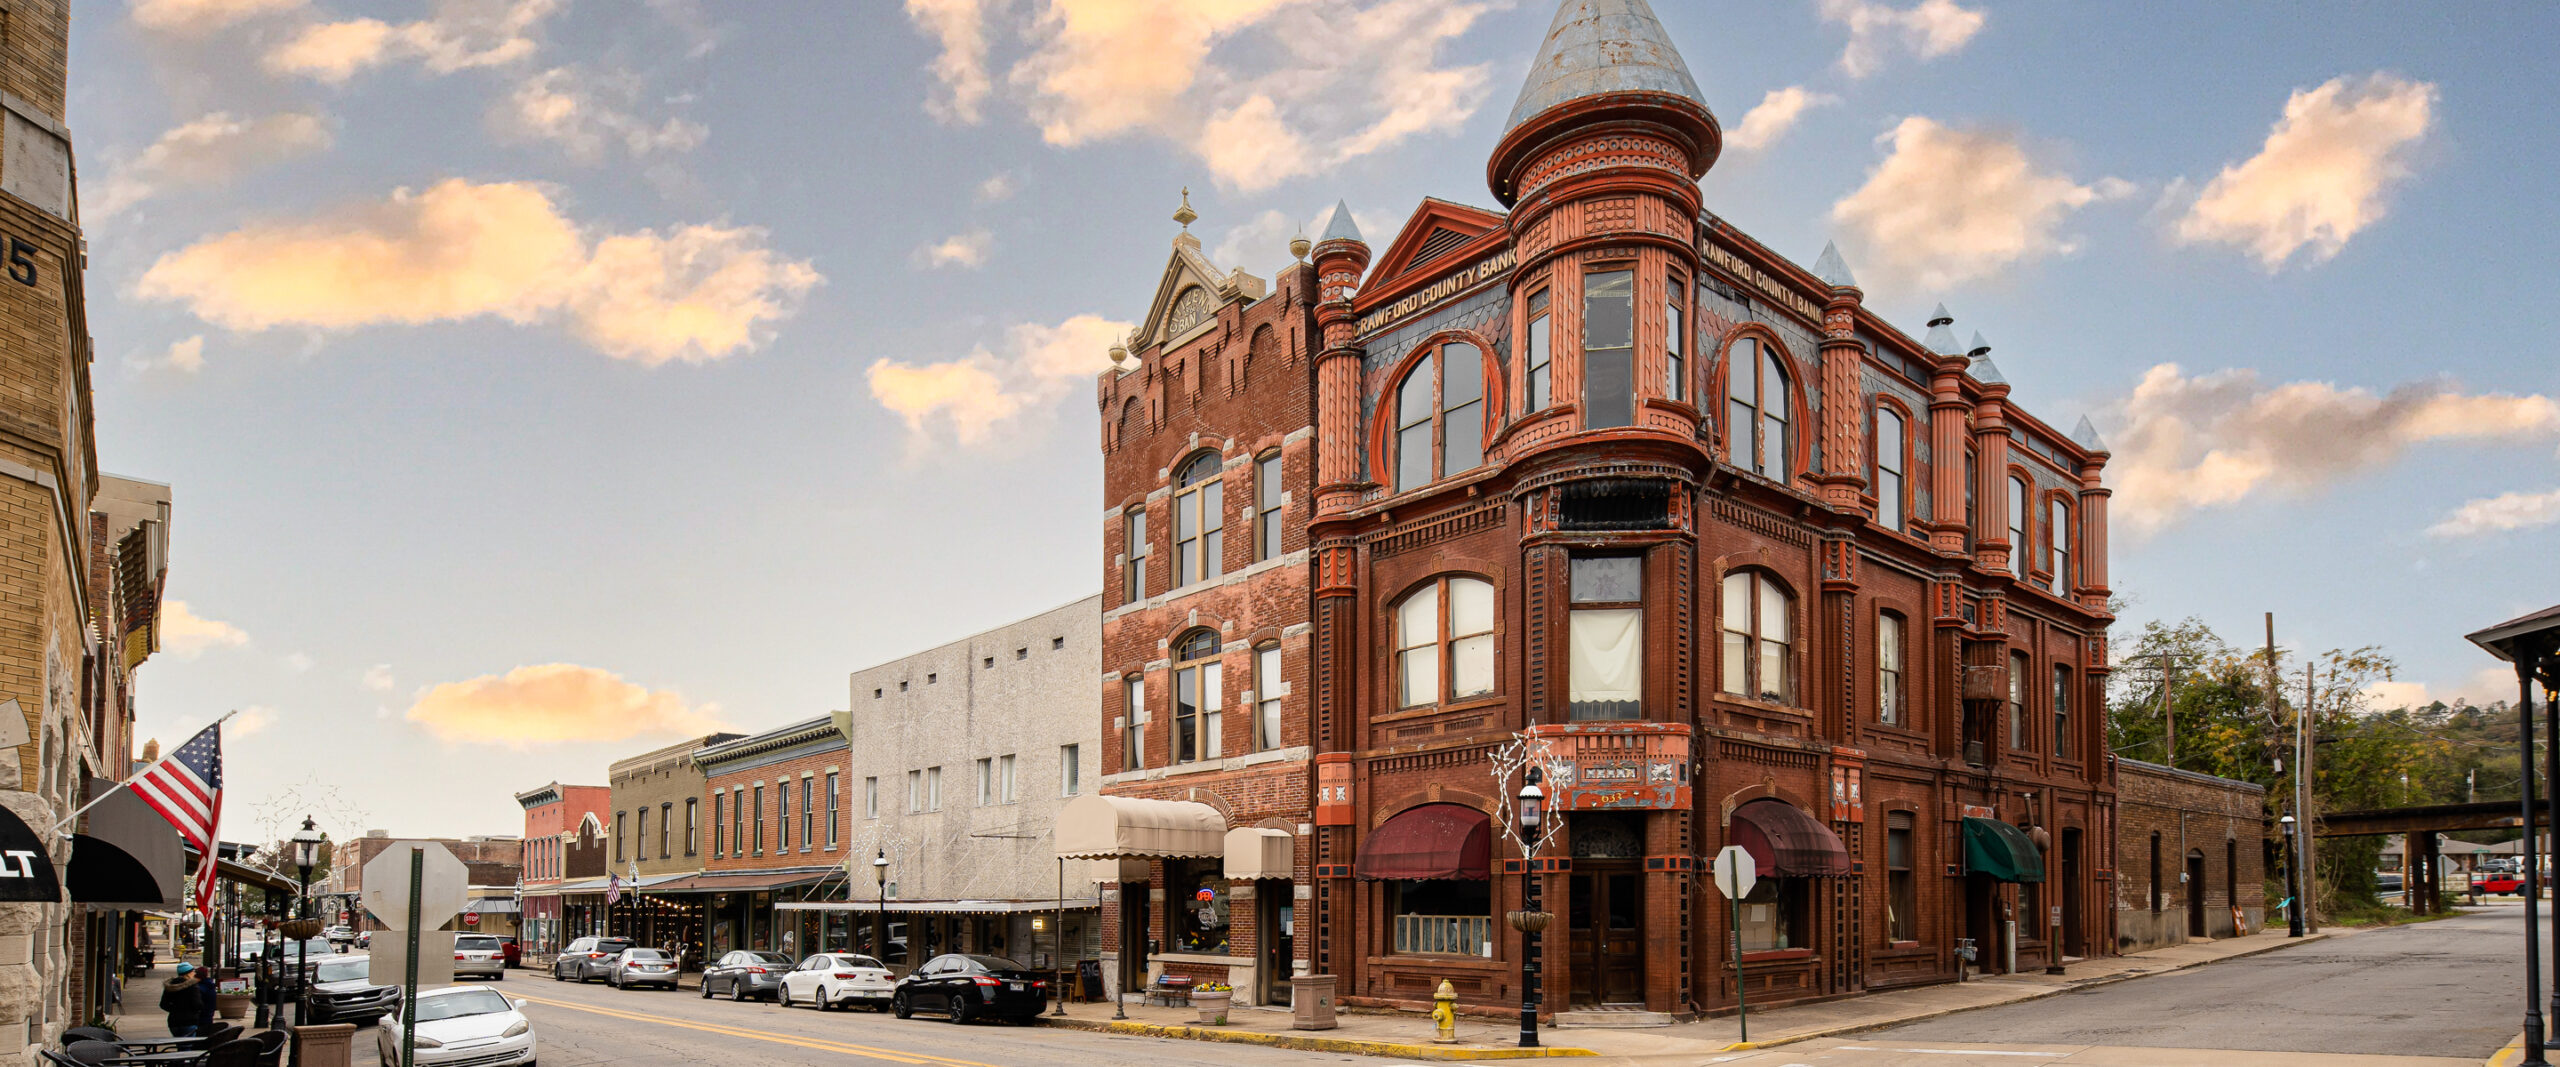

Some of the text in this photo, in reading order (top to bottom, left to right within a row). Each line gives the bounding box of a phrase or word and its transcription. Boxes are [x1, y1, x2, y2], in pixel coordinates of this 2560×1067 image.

[0, 233, 38, 287] 5
[1701, 238, 1823, 324] RAWFORD COUNTY BANK
[1170, 290, 1209, 332] CITIZENS
[1353, 248, 1517, 337] CRAWFORD COUNTY BANK
[1601, 792, 1623, 803] 633
